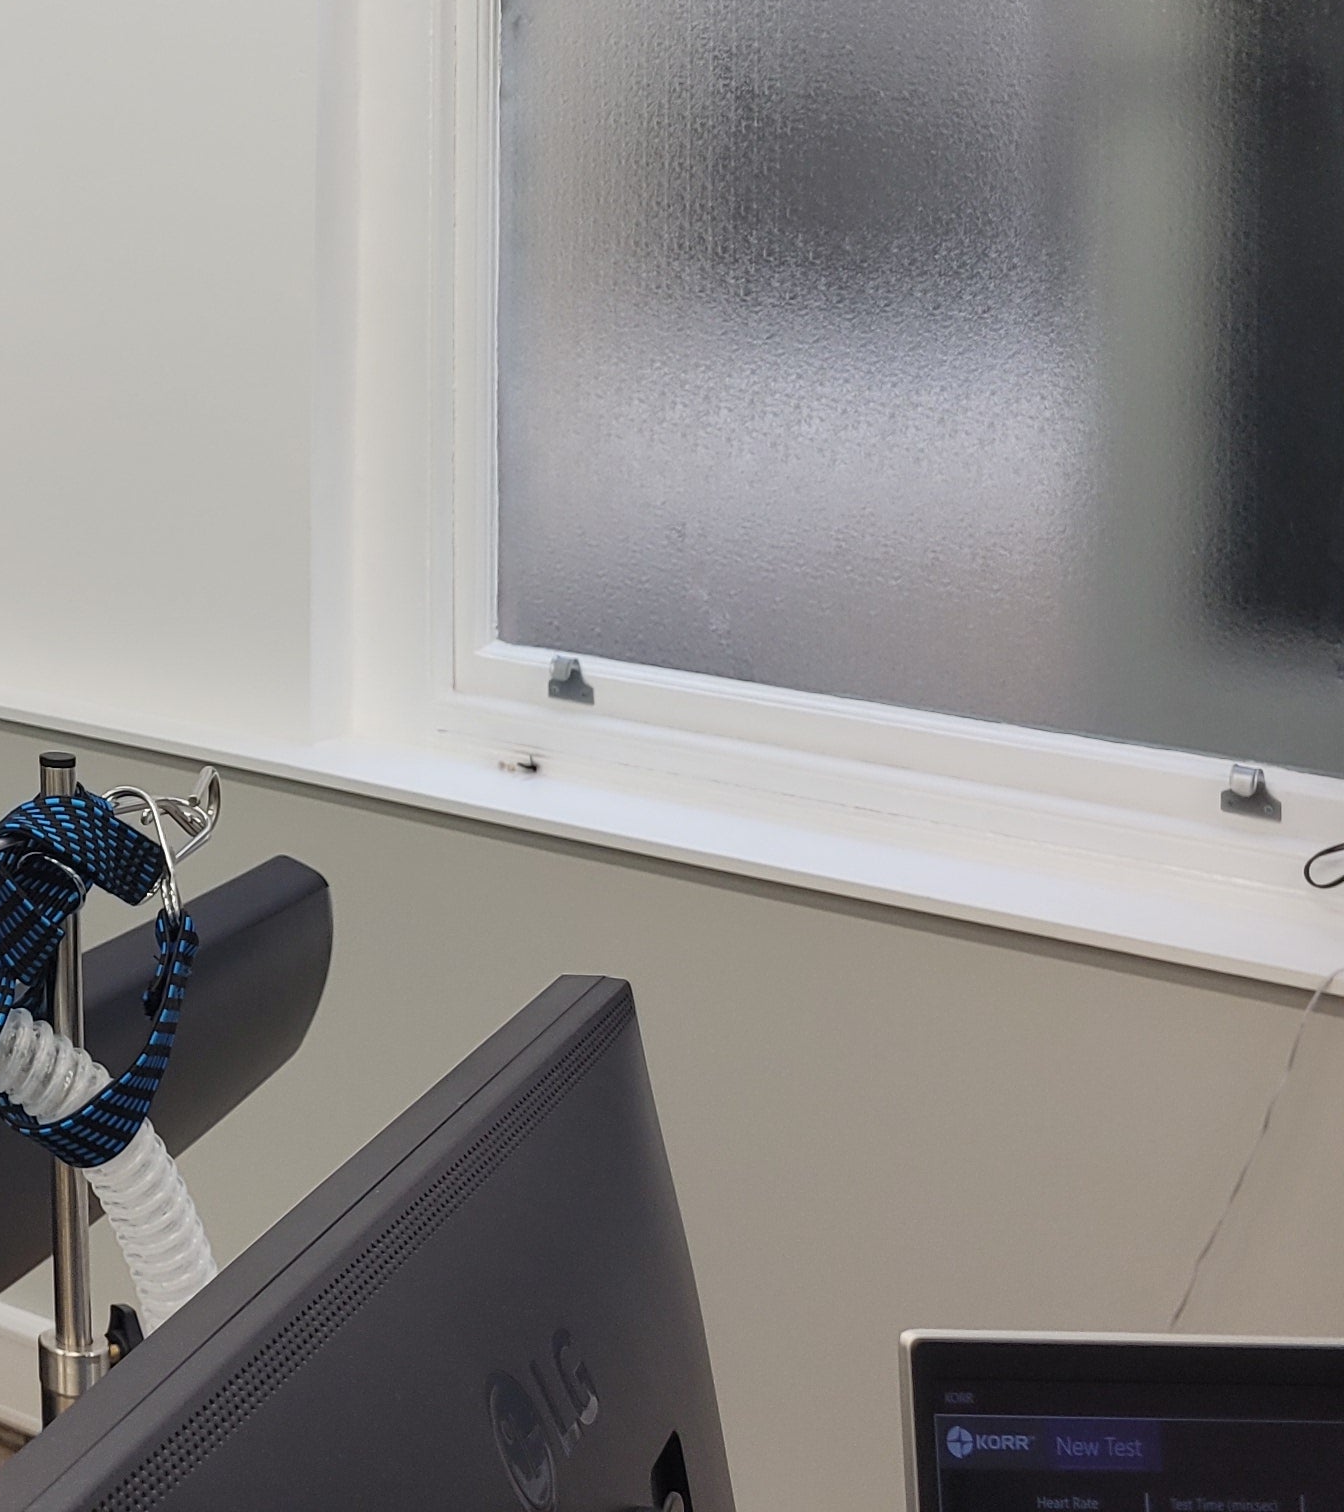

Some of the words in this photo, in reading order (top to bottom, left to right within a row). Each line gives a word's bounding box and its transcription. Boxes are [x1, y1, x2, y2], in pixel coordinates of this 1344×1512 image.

[1055, 1436, 1099, 1457] New
[1103, 1436, 1143, 1458] Test
[1036, 1496, 1069, 1510] Heart
[1072, 1497, 1099, 1511] Rate
[1170, 1498, 1193, 1511] Test
